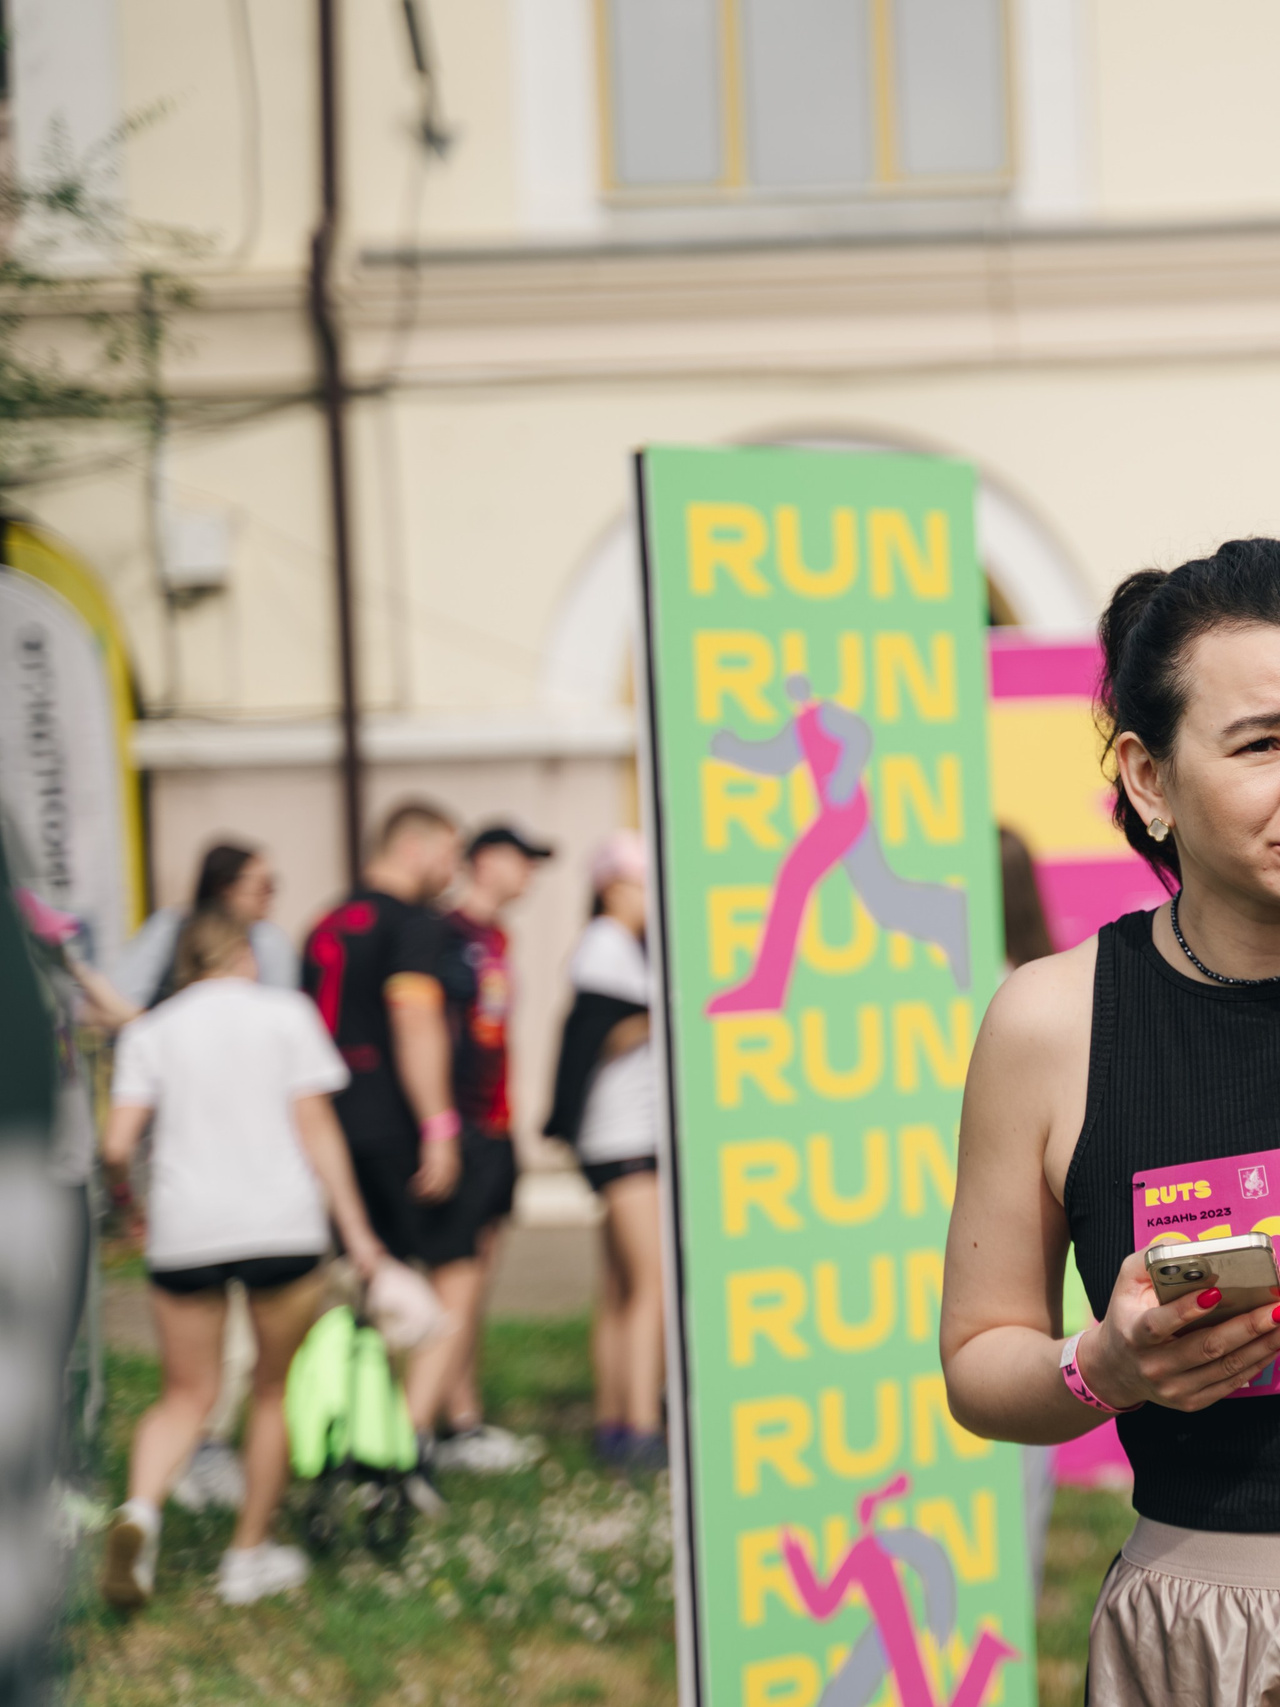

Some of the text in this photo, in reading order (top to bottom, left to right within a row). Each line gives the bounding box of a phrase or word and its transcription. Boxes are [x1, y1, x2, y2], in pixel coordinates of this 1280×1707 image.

[687, 502, 951, 600] RUN
[714, 999, 971, 1108] RUN
[1145, 1180, 1212, 1207] RUTS
[1147, 1207, 1232, 1228] КАЗАНЬ 2023
[733, 1374, 992, 1496] RUN
